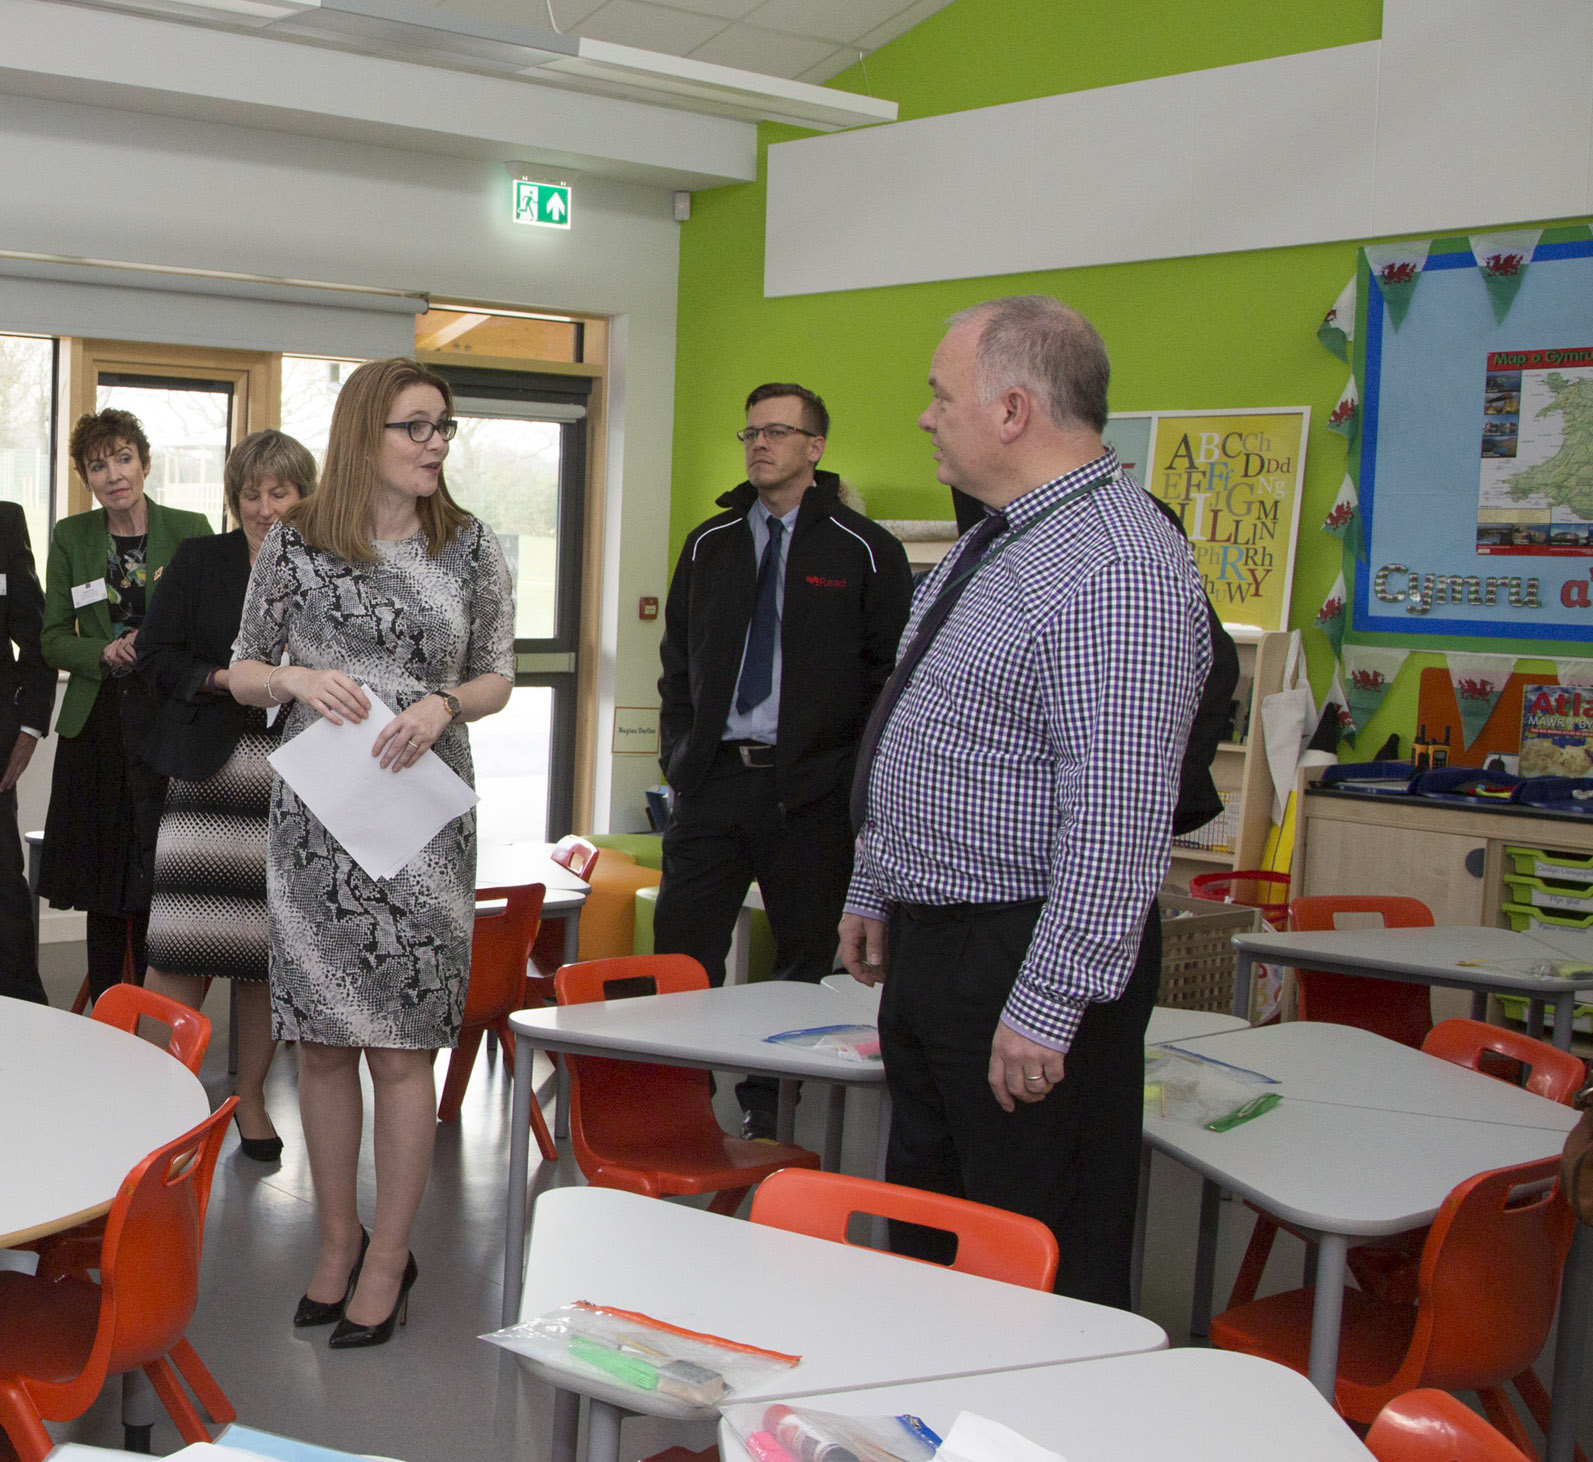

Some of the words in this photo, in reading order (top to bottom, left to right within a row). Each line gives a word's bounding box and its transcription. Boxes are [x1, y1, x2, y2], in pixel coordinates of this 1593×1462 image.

[1494, 353, 1528, 366] Map
[1532, 354, 1542, 363] o
[1546, 350, 1593, 364] Gymru
[1165, 433, 1199, 470] A
[1196, 432, 1220, 463] B
[1222, 432, 1242, 458] C
[1243, 432, 1271, 452] Ch
[1241, 453, 1265, 478] D
[1266, 458, 1291, 473] Dd
[1162, 473, 1182, 499] E
[1182, 470, 1206, 501] F
[1258, 476, 1286, 498] Ng
[1188, 493, 1212, 540] I
[1226, 482, 1255, 517] G
[1256, 500, 1280, 520] M
[1206, 509, 1232, 542] L
[1258, 522, 1278, 540] N
[1196, 546, 1220, 566] Ph
[1216, 546, 1247, 580] R
[1243, 547, 1273, 566] Rh
[1226, 582, 1253, 604] W
[1246, 568, 1273, 597] Y
[1374, 563, 1542, 615] Cymru
[1528, 716, 1564, 728] MAWR
